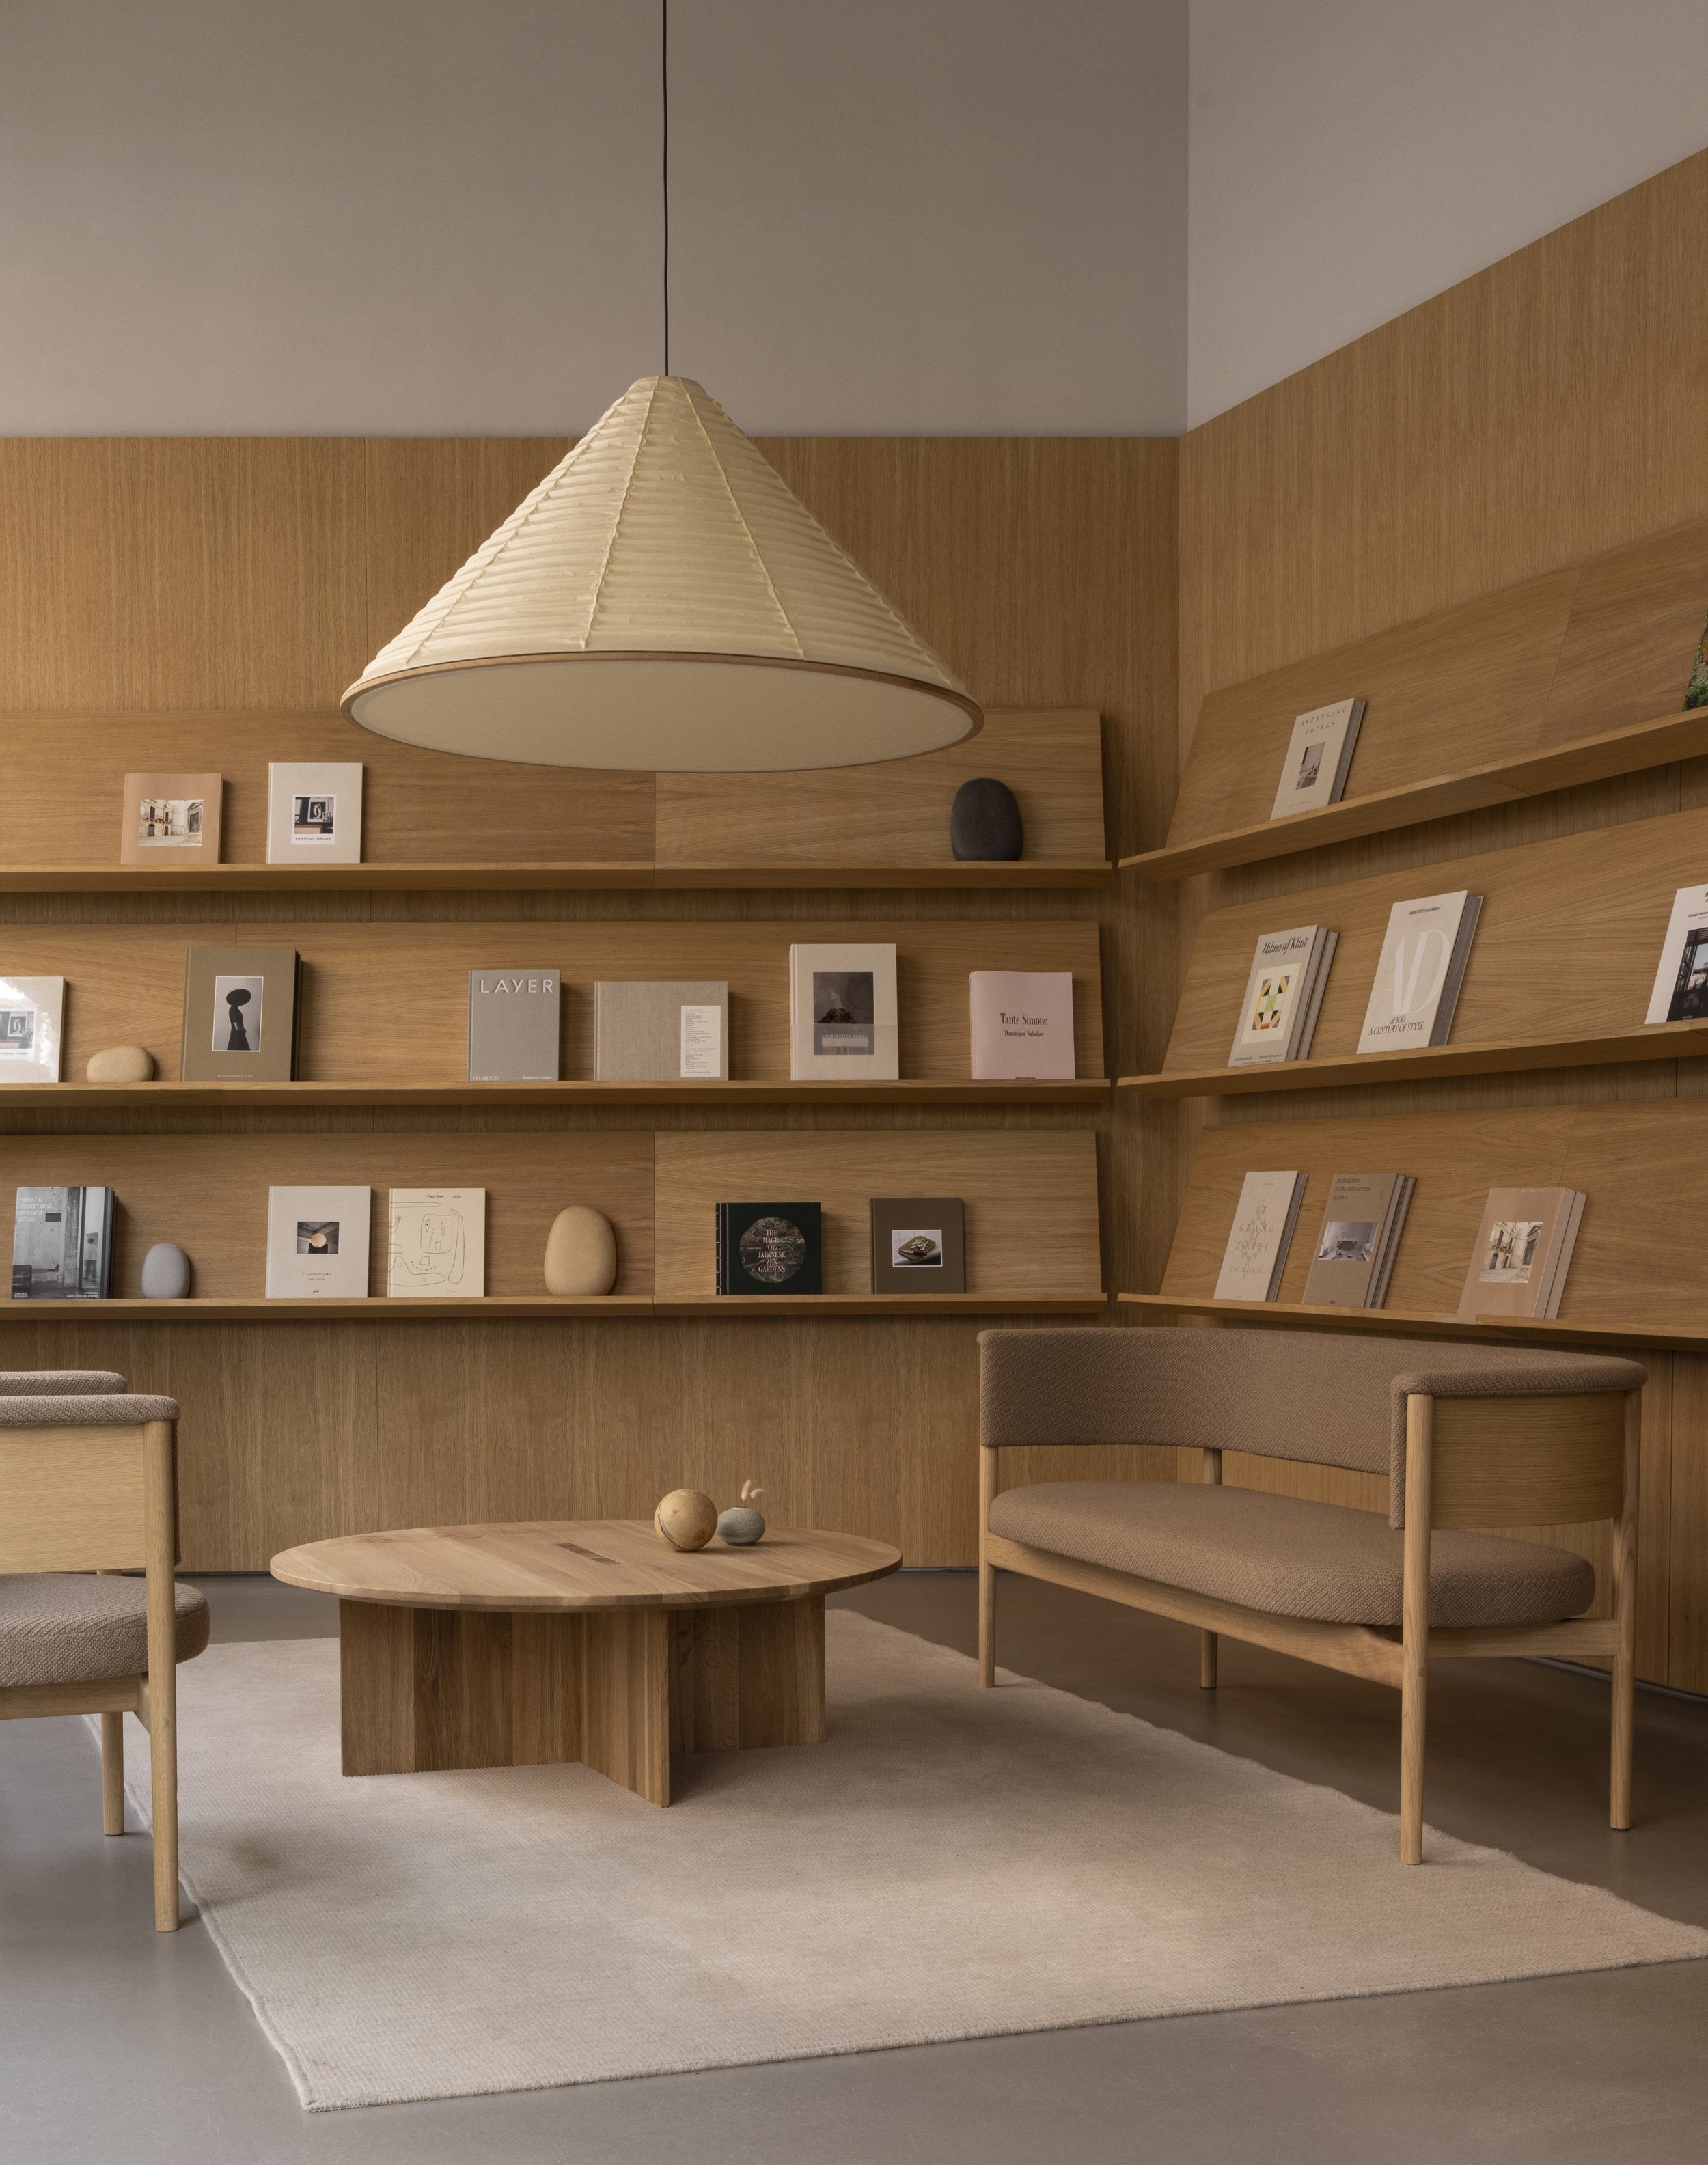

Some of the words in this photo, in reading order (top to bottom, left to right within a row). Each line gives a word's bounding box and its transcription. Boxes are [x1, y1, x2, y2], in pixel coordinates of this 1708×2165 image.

[1301, 707, 1347, 726] ARRANGING
[1306, 721, 1335, 735] THINGS
[1261, 941, 1282, 954] Hilma
[1282, 937, 1293, 955] af
[1290, 936, 1308, 950] Klint
[1367, 929, 1450, 1019] AD
[480, 979, 553, 993] LAYER
[1000, 1012, 1020, 1025] Tante
[1022, 1013, 1048, 1025] Simone
[1390, 1017, 1396, 1025] at
[1396, 1015, 1406, 1023] 100
[1004, 1030, 1025, 1038] Dominique
[1368, 1028, 1374, 1036] A
[1373, 1023, 1400, 1035] CENTURY
[1399, 1023, 1407, 1032] OF
[1406, 1021, 1425, 1031] STYLE
[1255, 1206, 1267, 1215] LE
[1239, 1224, 1274, 1233] GRAND
